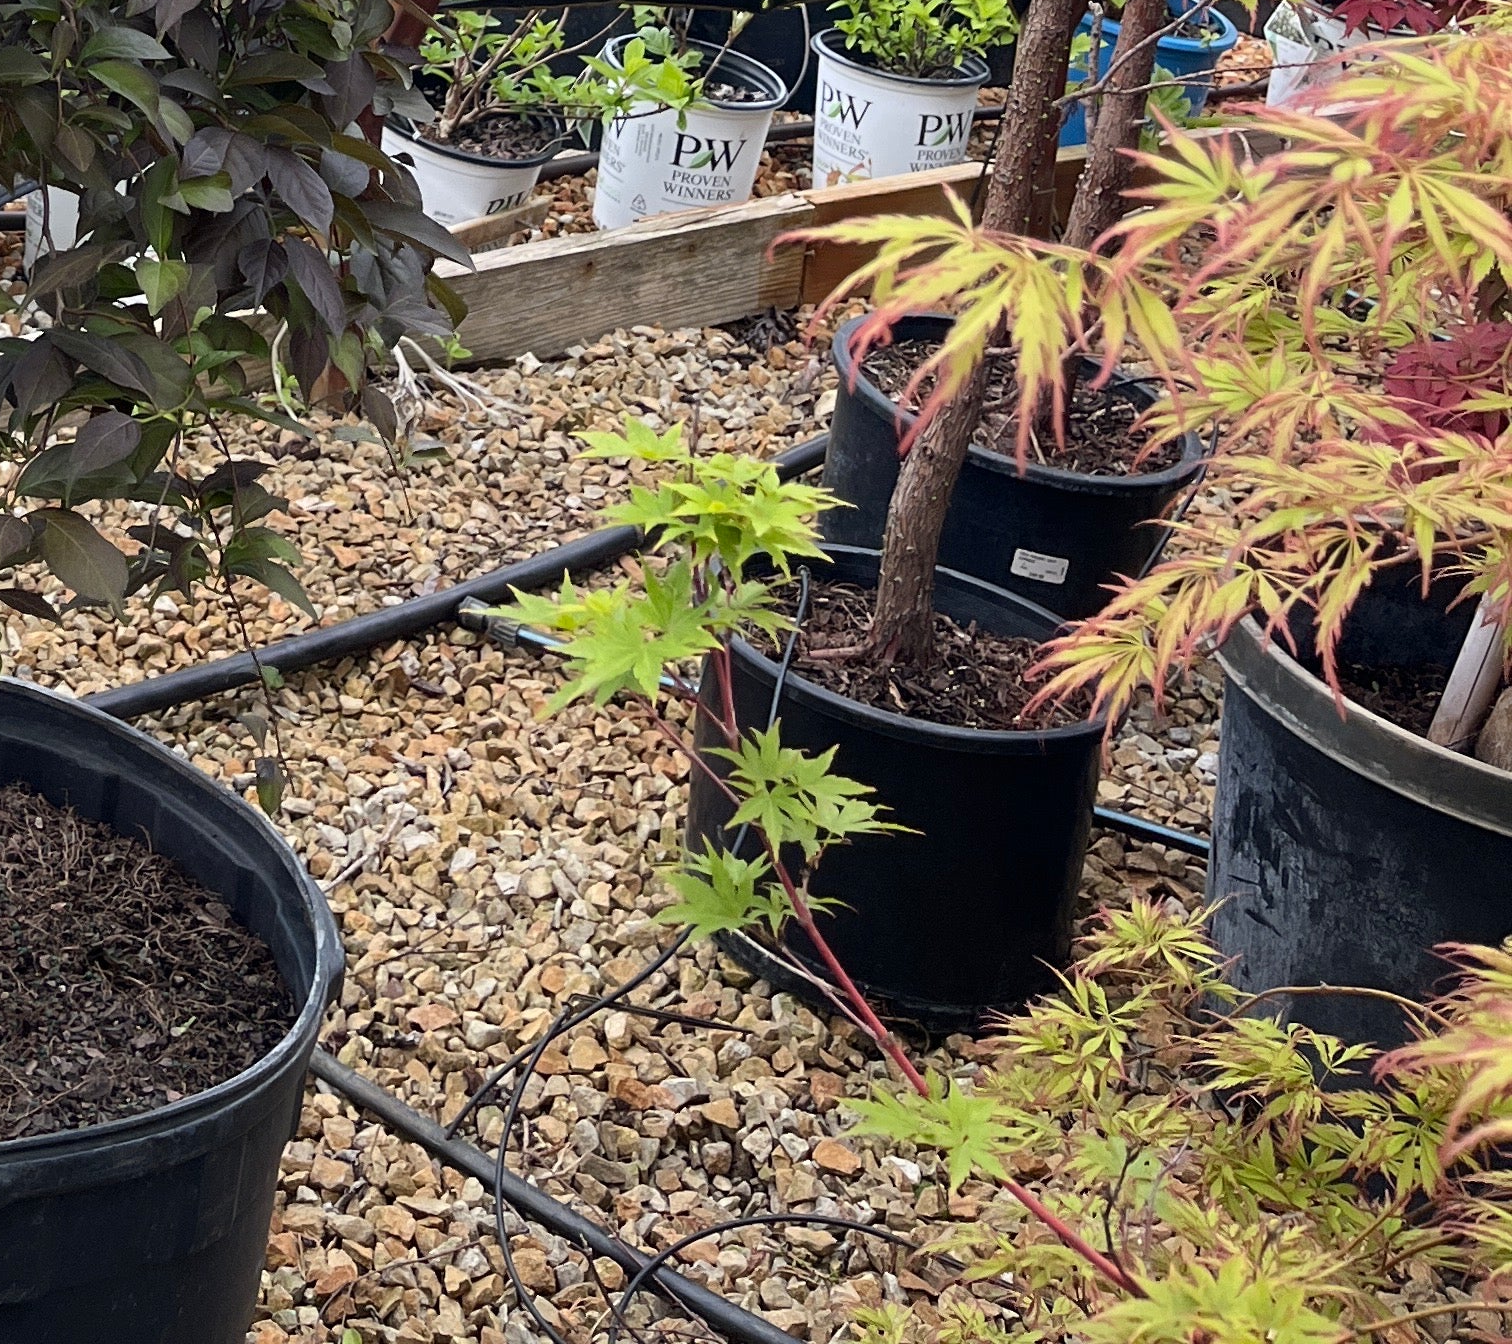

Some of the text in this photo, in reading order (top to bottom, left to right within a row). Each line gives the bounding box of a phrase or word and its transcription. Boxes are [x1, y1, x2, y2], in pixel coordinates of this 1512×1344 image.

[820, 81, 873, 130] PW
[915, 110, 972, 147] PW
[669, 131, 747, 173] PW
[663, 180, 733, 201] WINNERS
[672, 169, 732, 188] PROVEN
